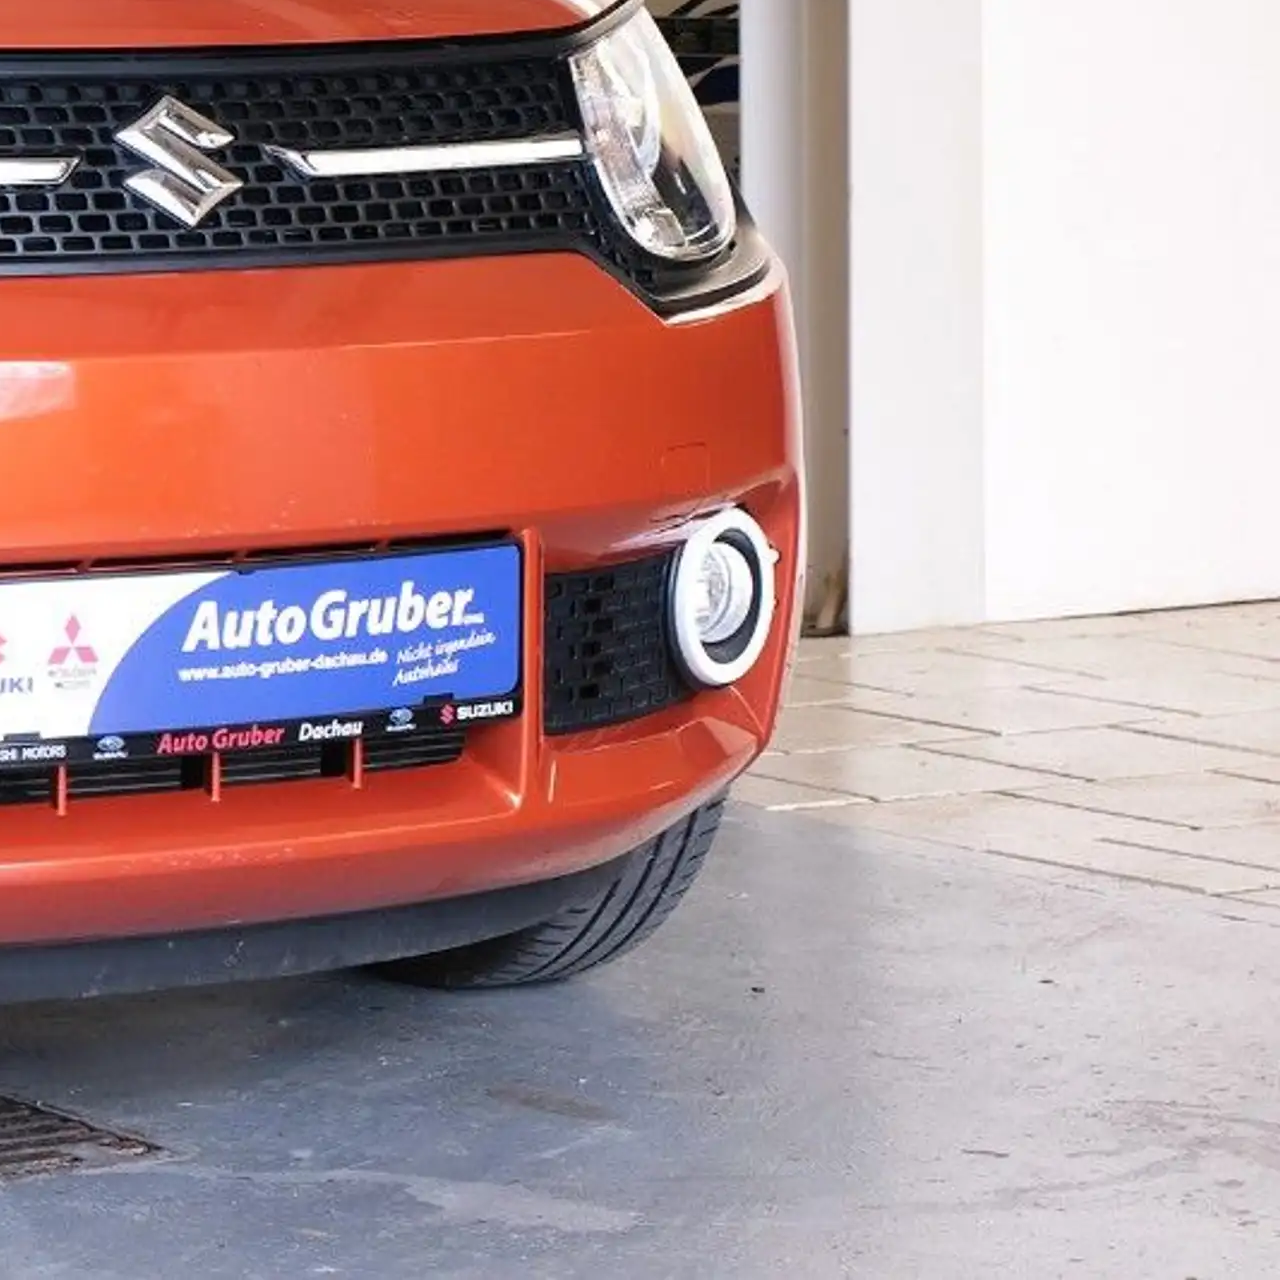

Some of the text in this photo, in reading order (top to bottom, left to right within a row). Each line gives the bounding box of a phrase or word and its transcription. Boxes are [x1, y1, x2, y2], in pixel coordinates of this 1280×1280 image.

[178, 648, 387, 682] www.auto-gruber-dachau.de
[456, 700, 514, 720] SUZUKI
[157, 730, 208, 755] Auto
[211, 725, 285, 749] Gruber
[299, 718, 363, 742] Dachau
